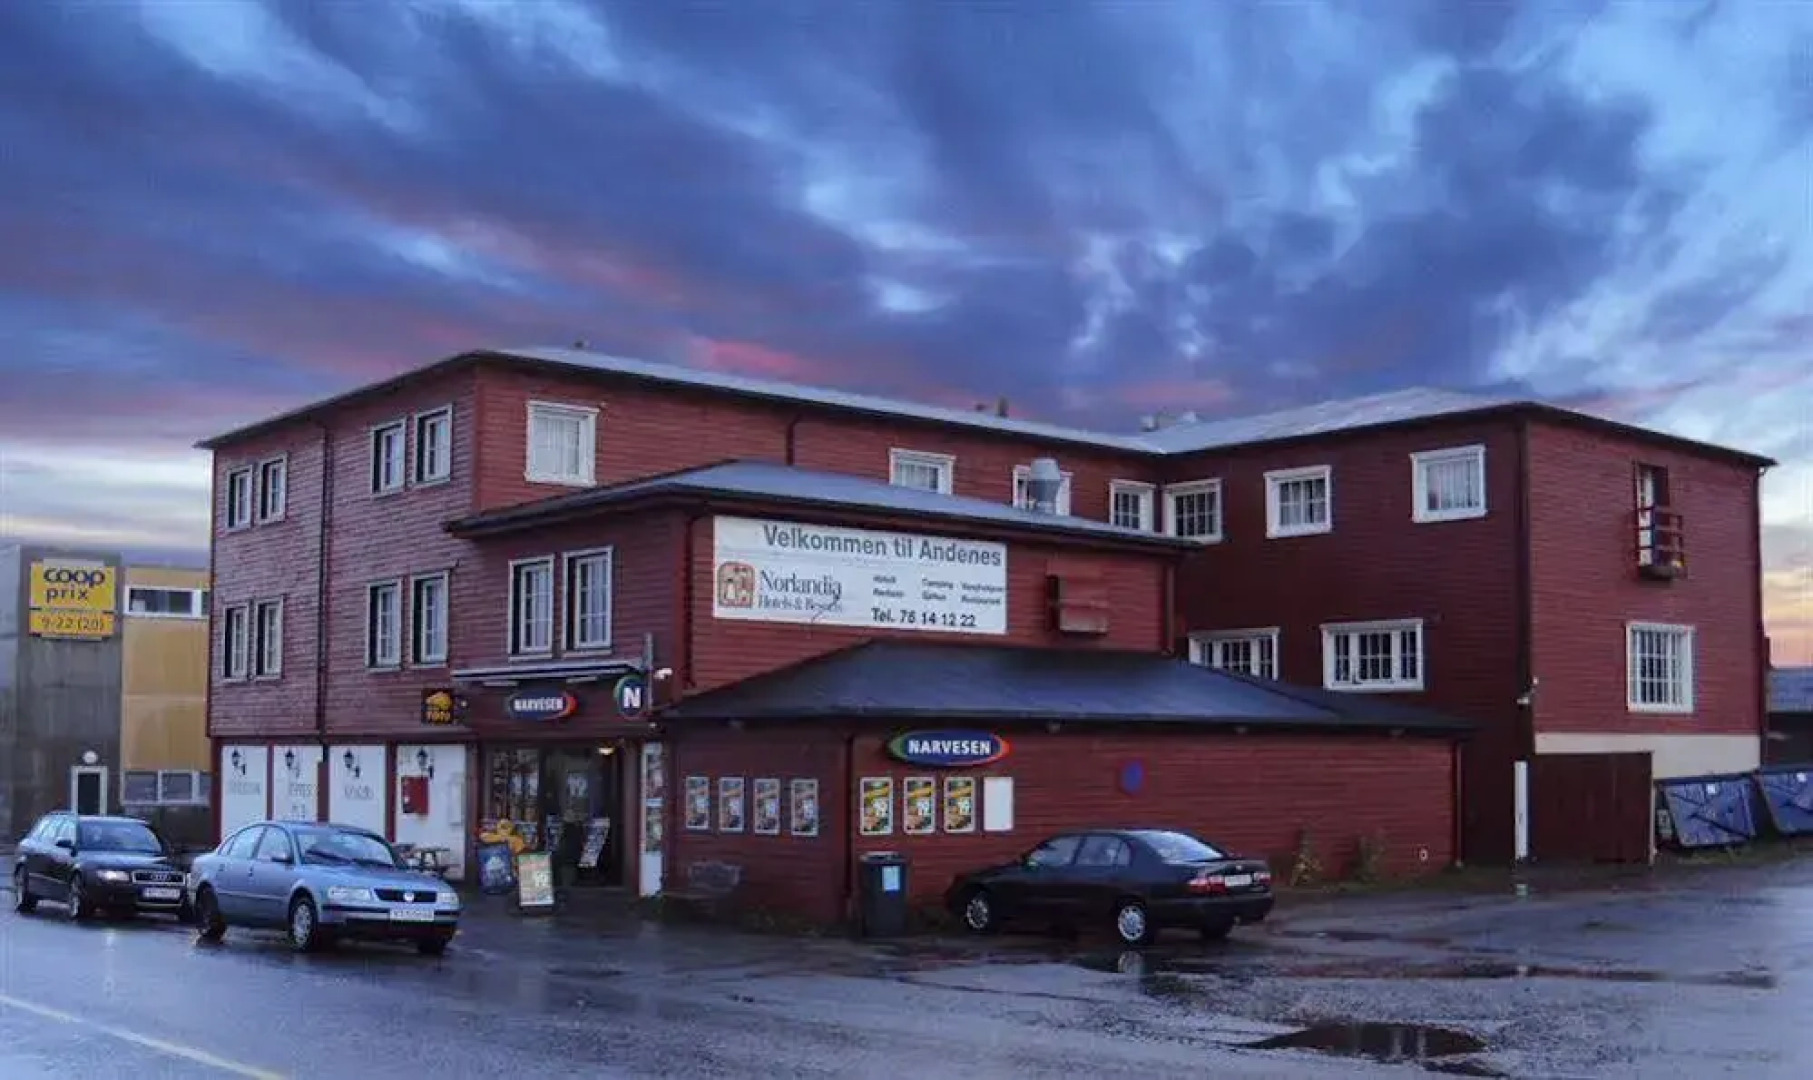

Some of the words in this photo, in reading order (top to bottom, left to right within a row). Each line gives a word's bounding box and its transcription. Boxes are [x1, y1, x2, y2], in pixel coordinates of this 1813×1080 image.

[763, 524, 888, 557] Velkommen
[894, 537, 914, 559] til
[918, 541, 1002, 567] Andenes
[44, 567, 105, 588] coop
[759, 569, 842, 598] Norlandia
[46, 584, 88, 602] prix
[871, 607, 896, 623] Tel.
[921, 611, 936, 625] 14
[941, 612, 957, 626] 12
[960, 614, 976, 628] 22
[513, 696, 564, 712] NARVESEN
[624, 687, 642, 709] N
[908, 739, 992, 756] NARVESEN
